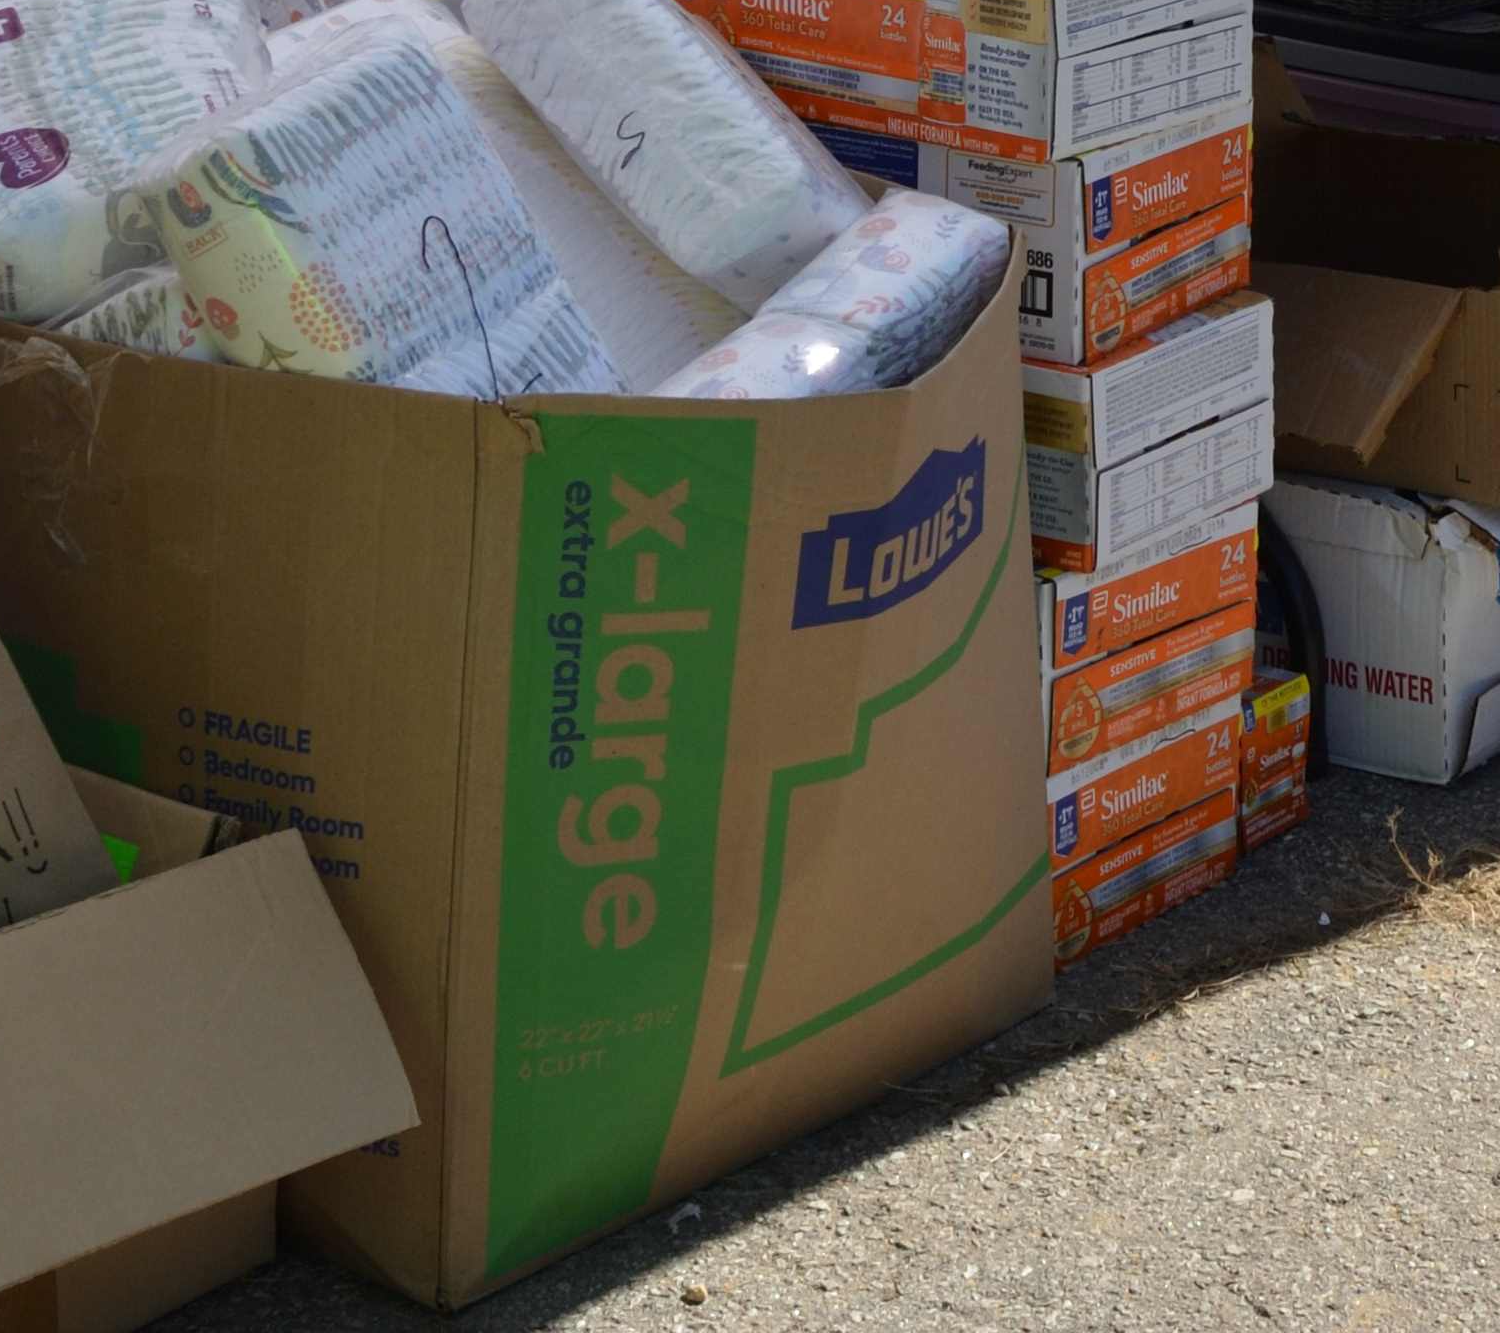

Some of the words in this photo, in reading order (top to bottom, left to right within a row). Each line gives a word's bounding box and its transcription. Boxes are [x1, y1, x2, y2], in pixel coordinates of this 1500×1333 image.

[740, 9, 764, 27] 360
[766, 14, 796, 33] Total
[798, 22, 826, 39] Care
[881, 4, 907, 29] 24
[924, 35, 961, 55] Similac
[886, 116, 918, 140] INFANT
[919, 123, 961, 150] FORMULA
[1221, 133, 1243, 166] 24
[1132, 170, 1190, 212] Similac
[1130, 241, 1169, 270] SENSITIVE
[556, 479, 593, 600] extra
[826, 476, 976, 607] LOWE'S
[1219, 540, 1246, 571] 24
[1112, 580, 1181, 624] Similac
[1109, 646, 1157, 678] SENSITIVE
[1263, 646, 1359, 690] DRING
[1363, 665, 1434, 705] WATER
[546, 612, 587, 770] grande
[558, 473, 712, 951] x-large
[203, 710, 313, 755] FRAGILE
[1206, 731, 1232, 758] 24
[203, 749, 317, 794] Bedroom
[1100, 772, 1168, 821] Similac
[288, 806, 365, 841] Room
[1099, 844, 1145, 875] SENSITIVE
